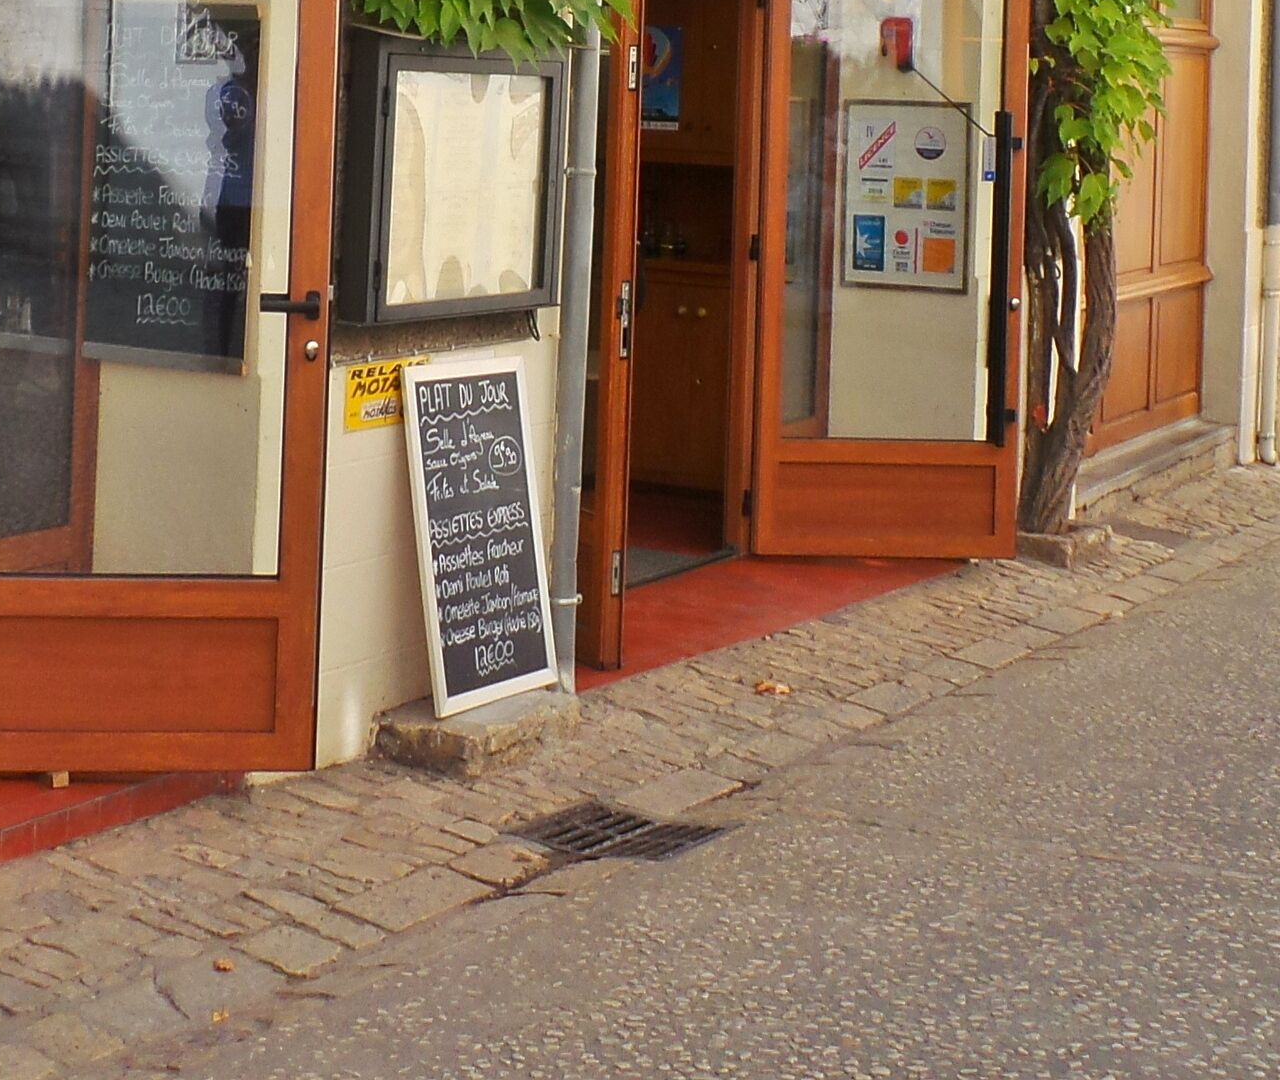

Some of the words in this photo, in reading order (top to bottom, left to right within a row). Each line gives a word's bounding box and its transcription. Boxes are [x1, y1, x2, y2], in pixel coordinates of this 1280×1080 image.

[95, 144, 169, 165] ASSIETTES
[145, 262, 184, 291] Burger
[137, 293, 192, 317] 12€00
[419, 383, 452, 414] PLAT
[459, 383, 473, 408] DU
[478, 380, 509, 403] JOUR
[429, 510, 483, 539] ASSIETTES
[487, 501, 525, 528] EXPRESS
[439, 545, 485, 573] Assiettes
[447, 625, 476, 646] Cheese
[475, 639, 514, 670] 12€00
